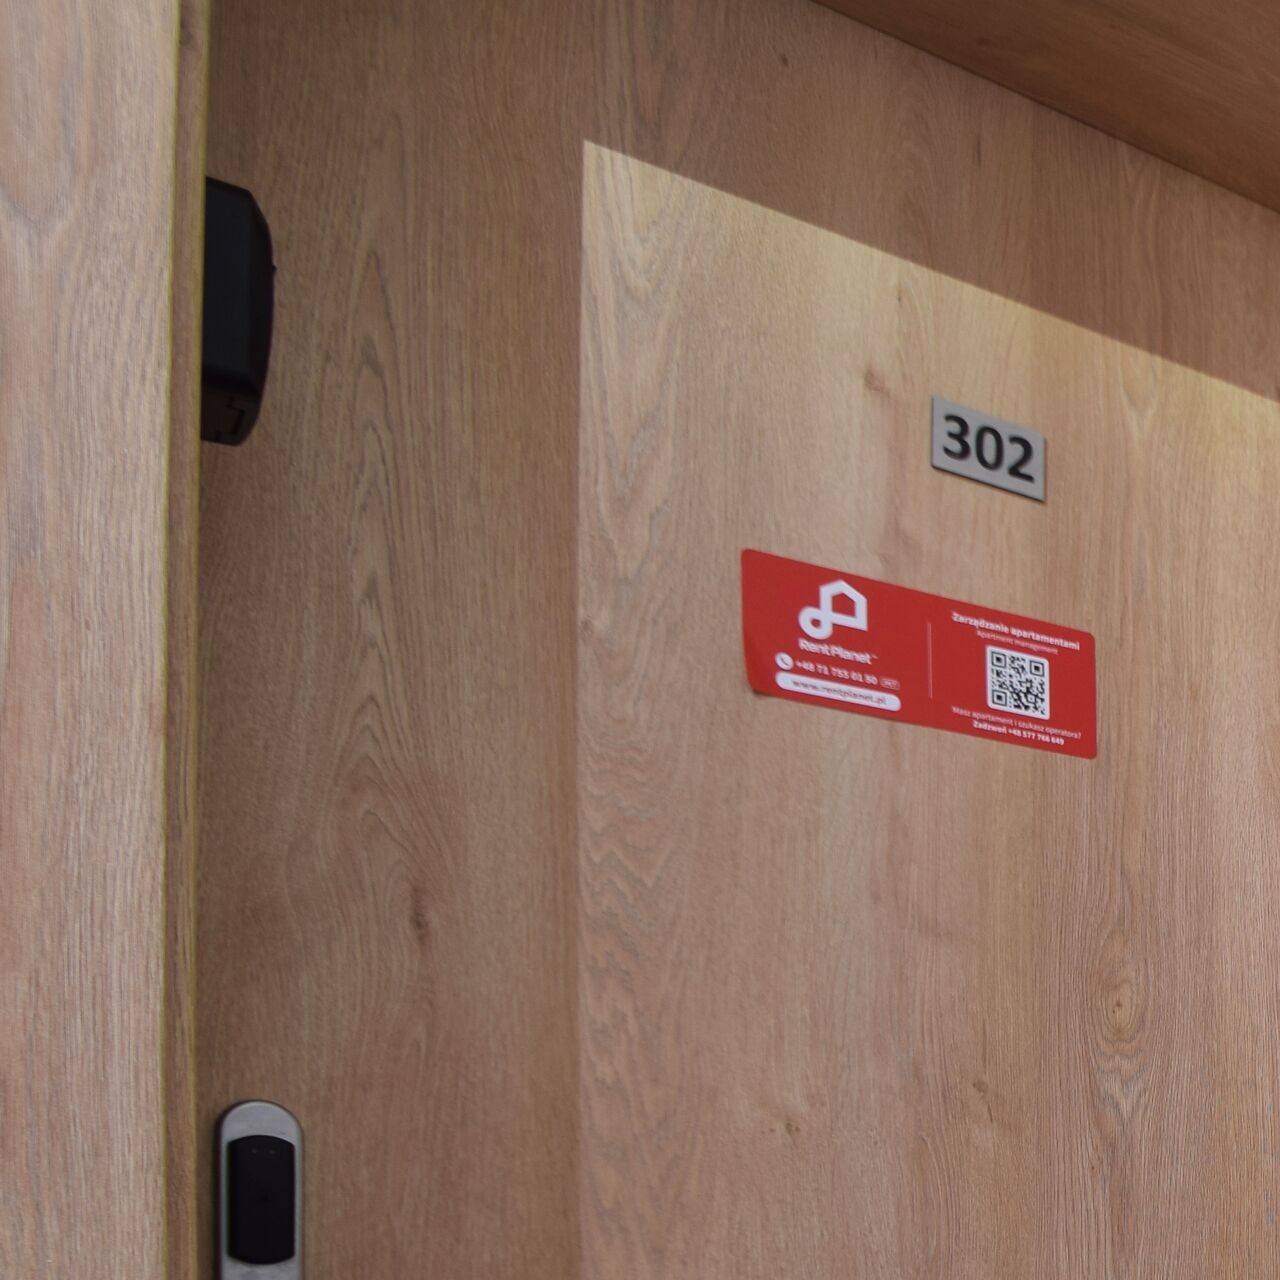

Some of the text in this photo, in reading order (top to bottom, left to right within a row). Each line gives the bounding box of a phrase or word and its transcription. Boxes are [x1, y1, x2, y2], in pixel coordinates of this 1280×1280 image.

[942, 412, 1035, 484] 302
[952, 611, 1080, 651] Zarządzanie apartamentami
